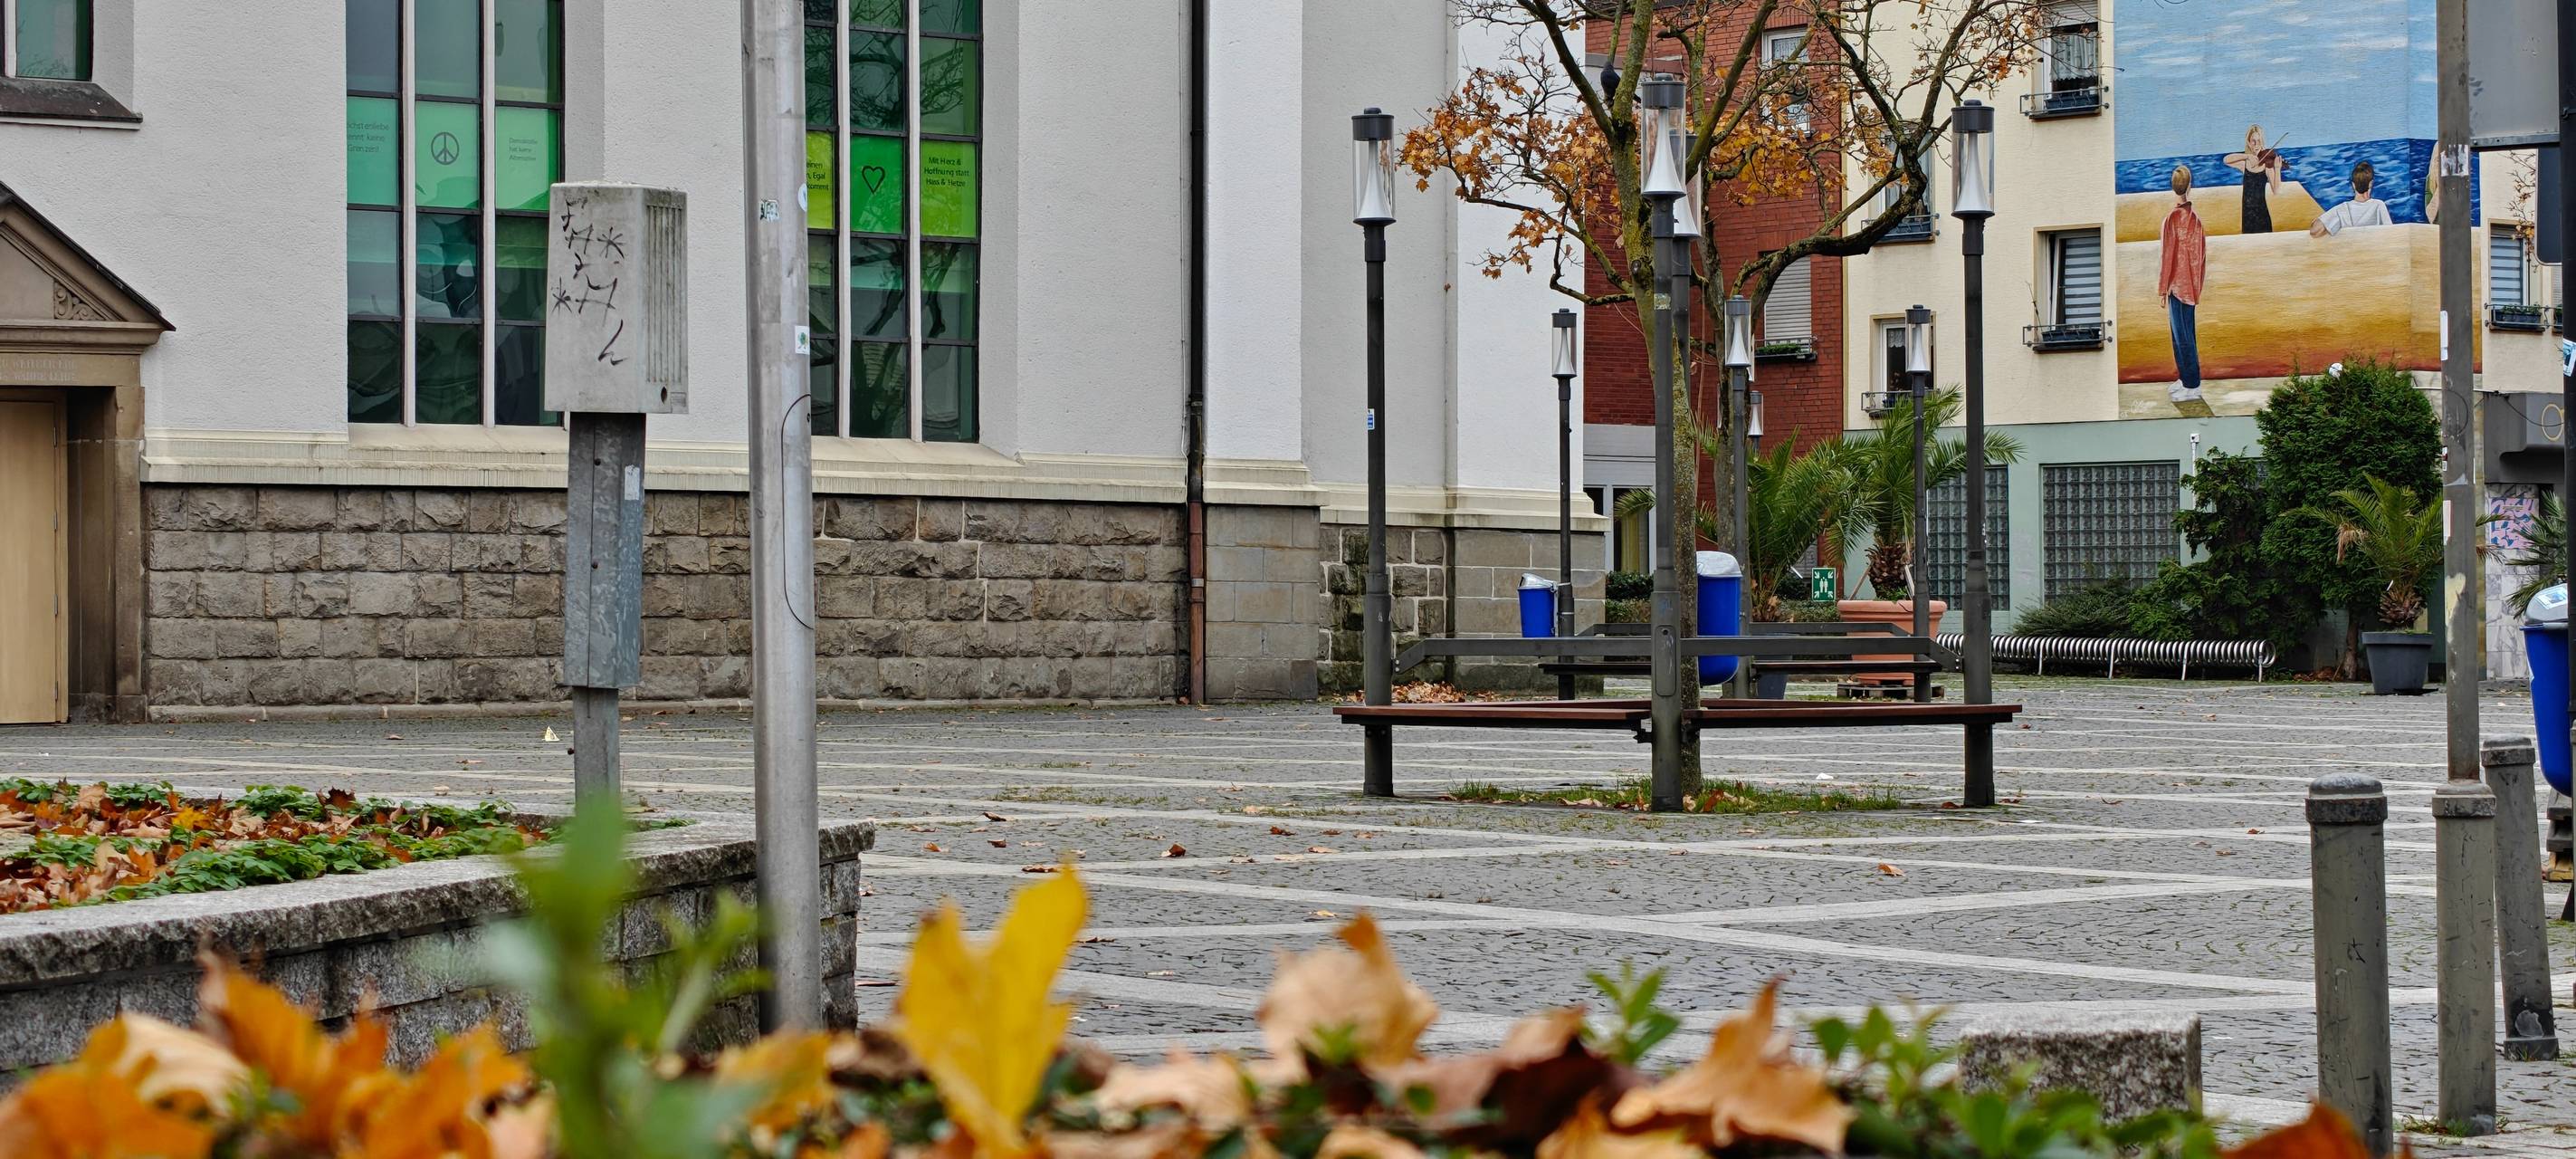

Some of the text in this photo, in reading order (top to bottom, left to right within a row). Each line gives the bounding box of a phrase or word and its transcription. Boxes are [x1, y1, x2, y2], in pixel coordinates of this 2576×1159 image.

[928, 157, 939, 165] Mit
[940, 158, 956, 166] Herz
[813, 172, 825, 181] Egal
[923, 167, 954, 177] Hoffnung
[926, 177, 940, 186] Hass
[948, 178, 966, 187] Hetze
